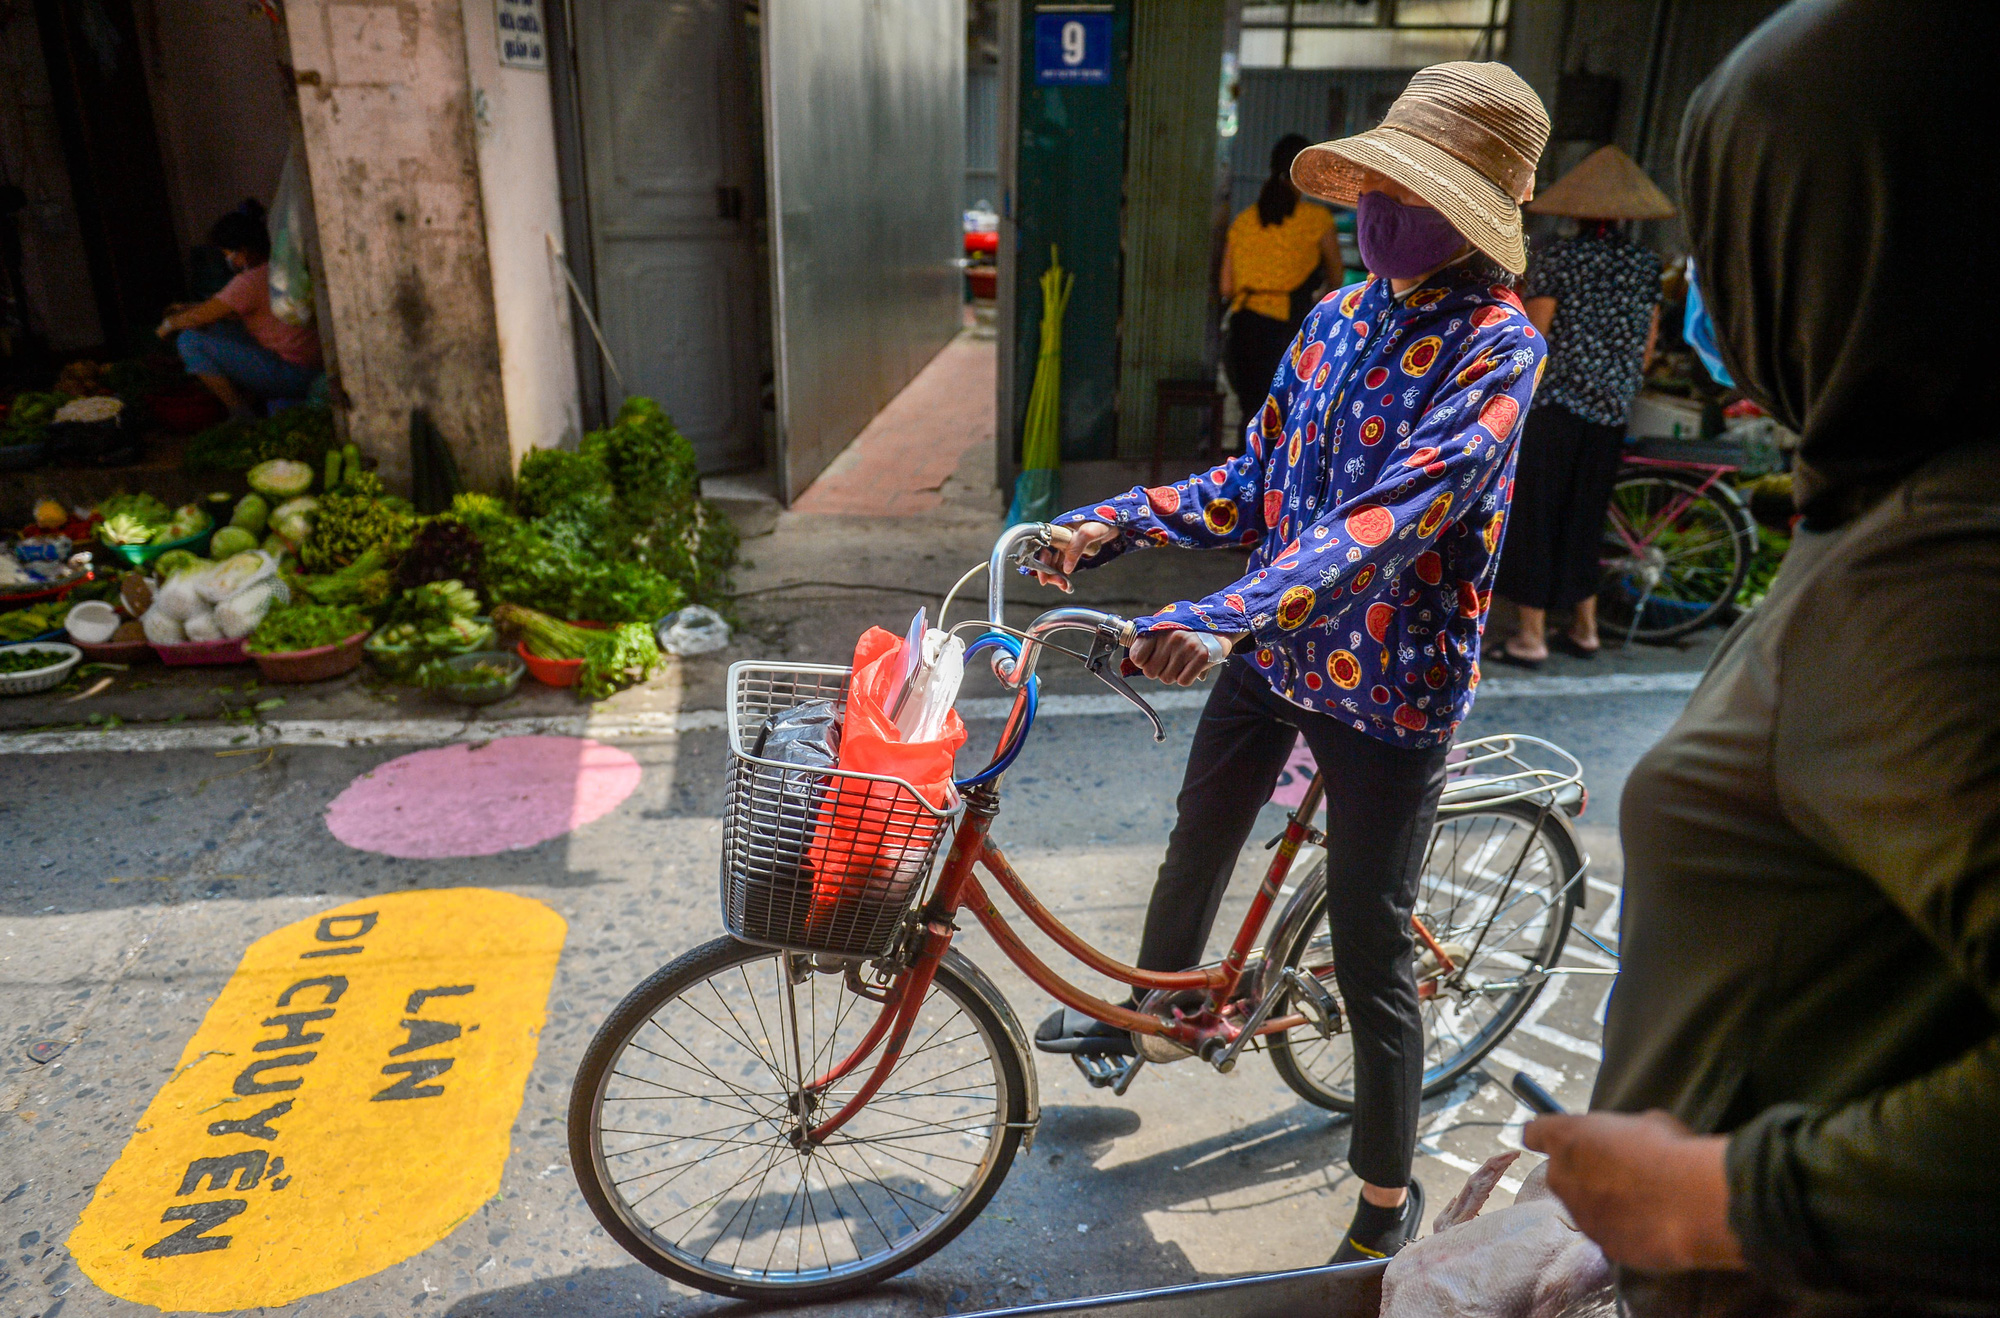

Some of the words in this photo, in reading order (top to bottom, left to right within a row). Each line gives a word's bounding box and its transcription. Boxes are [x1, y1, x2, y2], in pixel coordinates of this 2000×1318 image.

[1061, 20, 1085, 66] 9
[301, 911, 379, 959] DI
[370, 985, 480, 1102] LÀN
